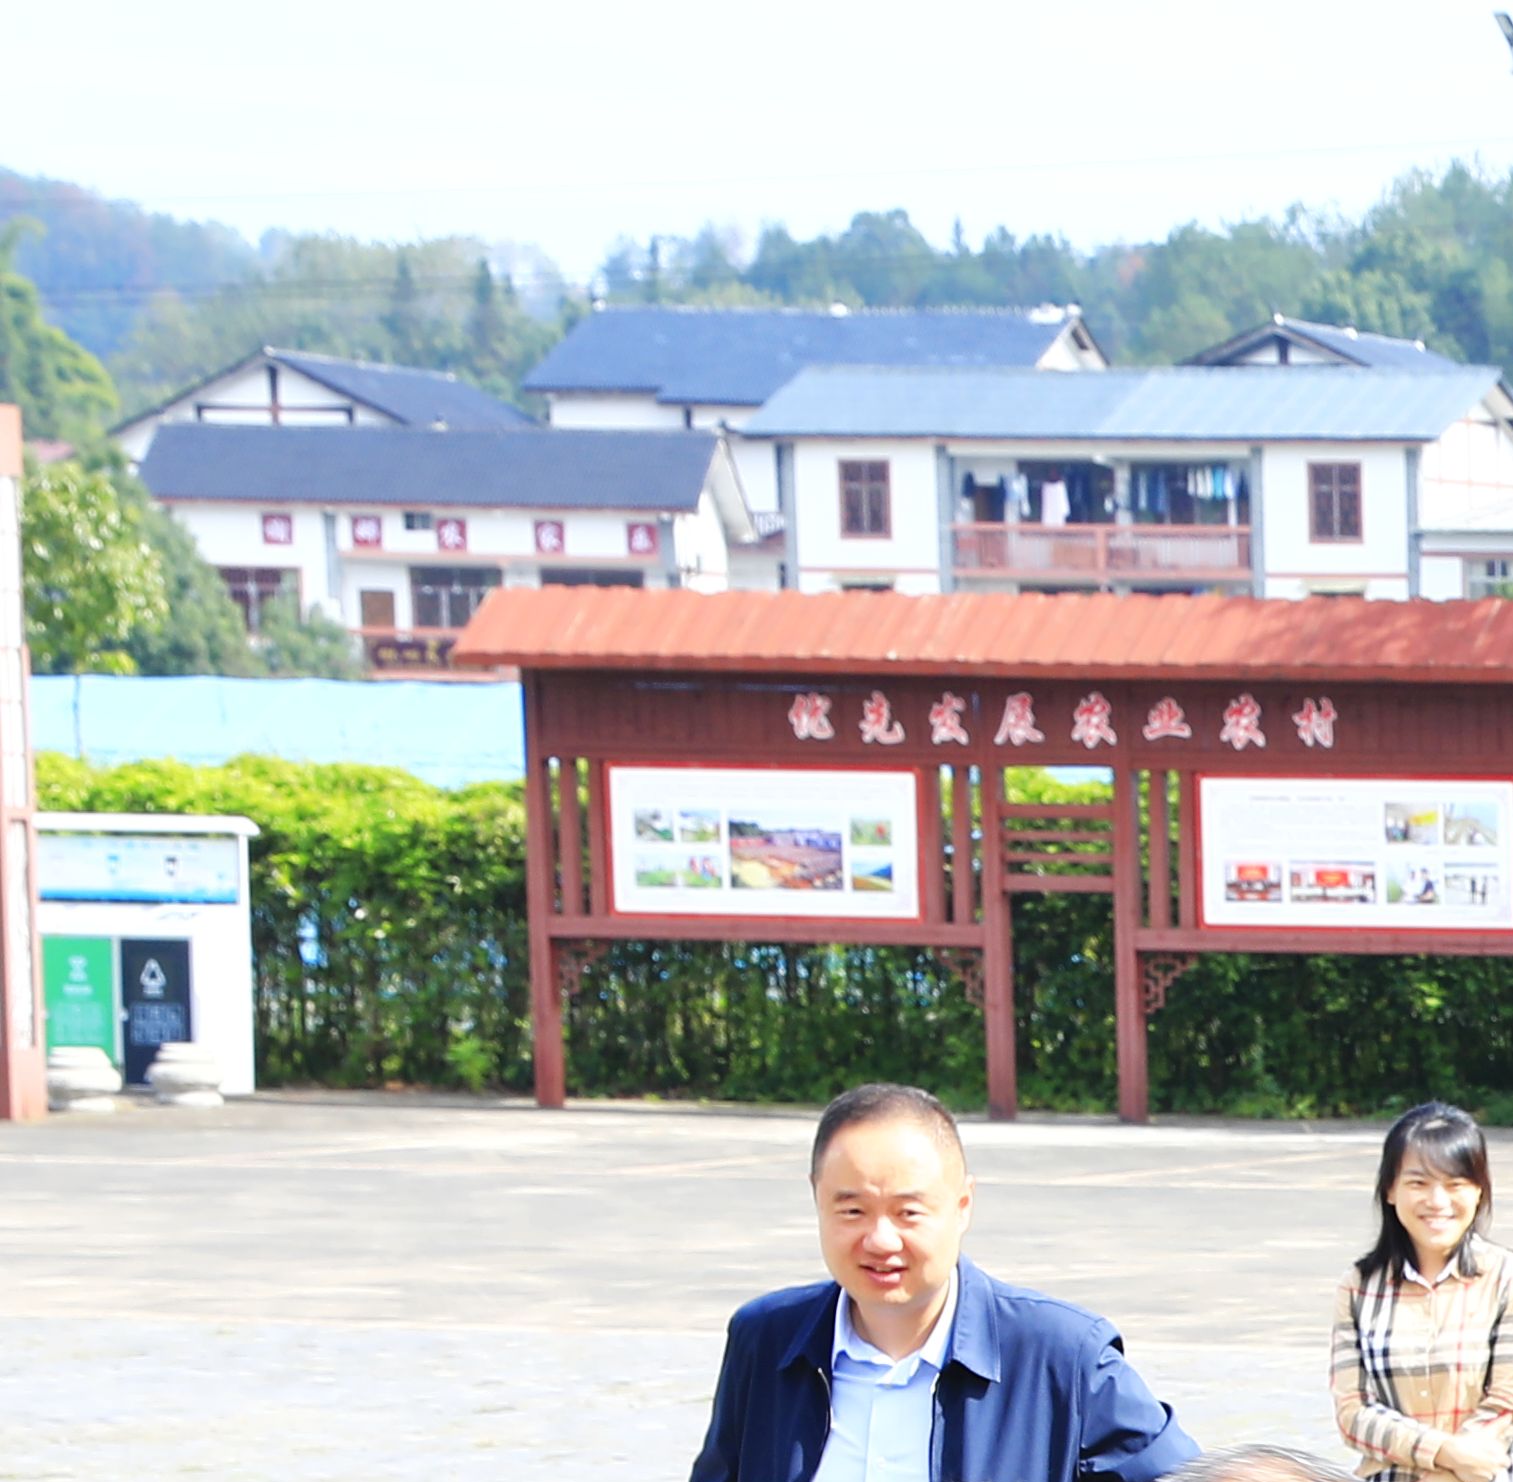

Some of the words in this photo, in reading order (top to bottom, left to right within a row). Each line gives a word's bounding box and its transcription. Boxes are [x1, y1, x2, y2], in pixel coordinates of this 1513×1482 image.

[788, 692, 1336, 750] 优先发展农业农村
